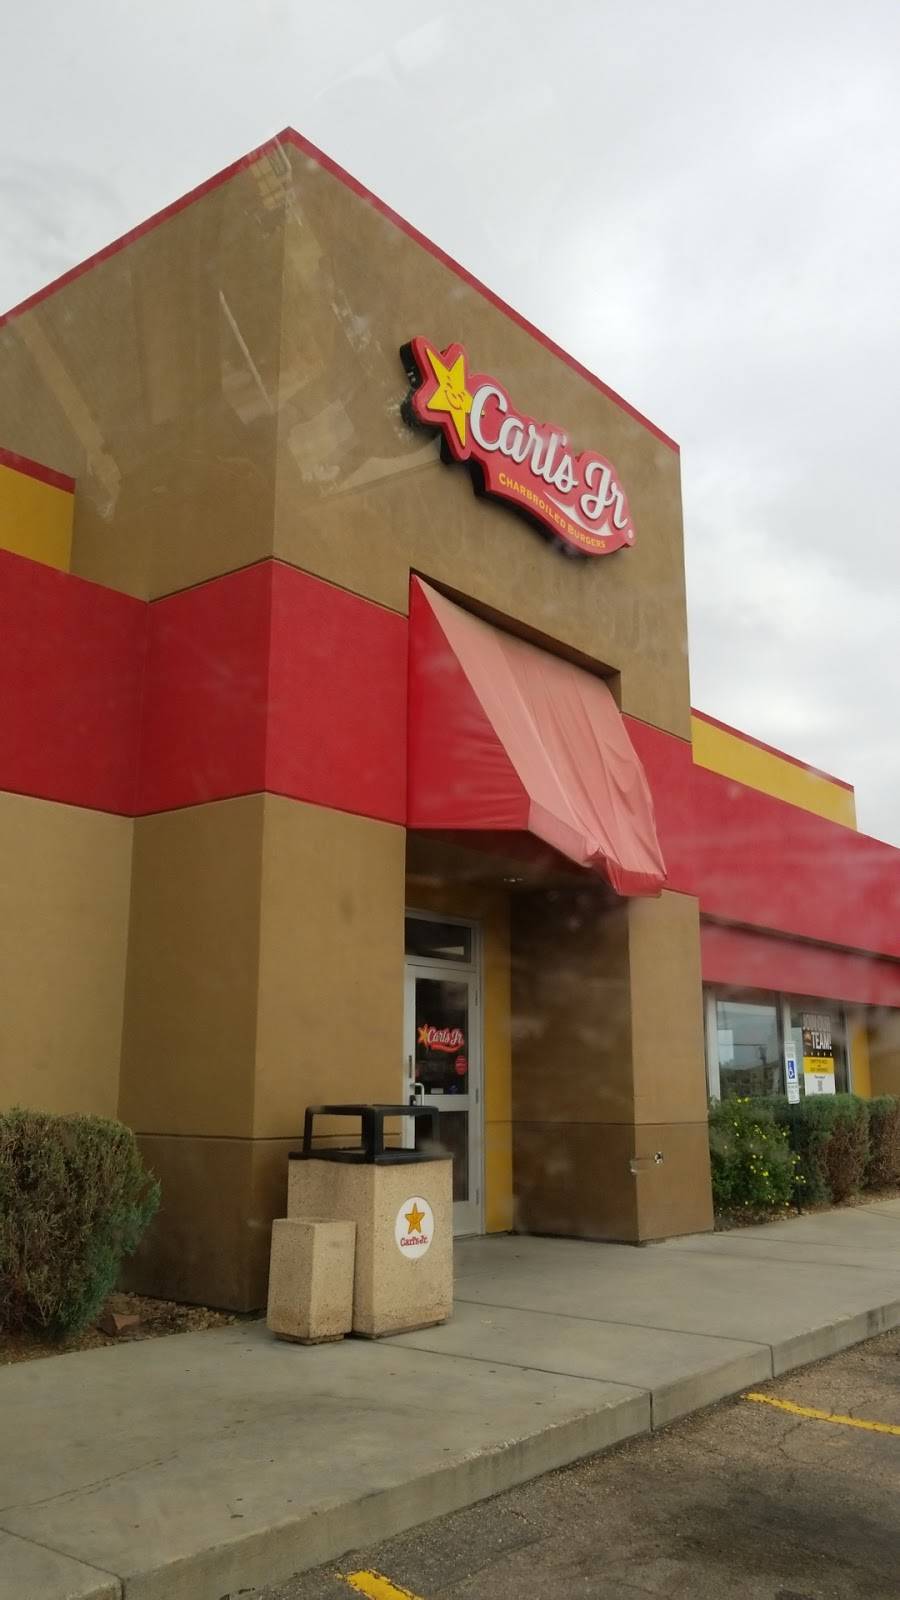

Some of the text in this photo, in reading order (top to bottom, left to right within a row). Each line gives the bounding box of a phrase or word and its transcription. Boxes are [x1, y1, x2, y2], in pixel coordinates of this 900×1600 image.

[470, 384, 579, 494] Carl's
[498, 472, 606, 549] CHARBROILED BURGERS
[811, 1031, 832, 1050] TEAM!
